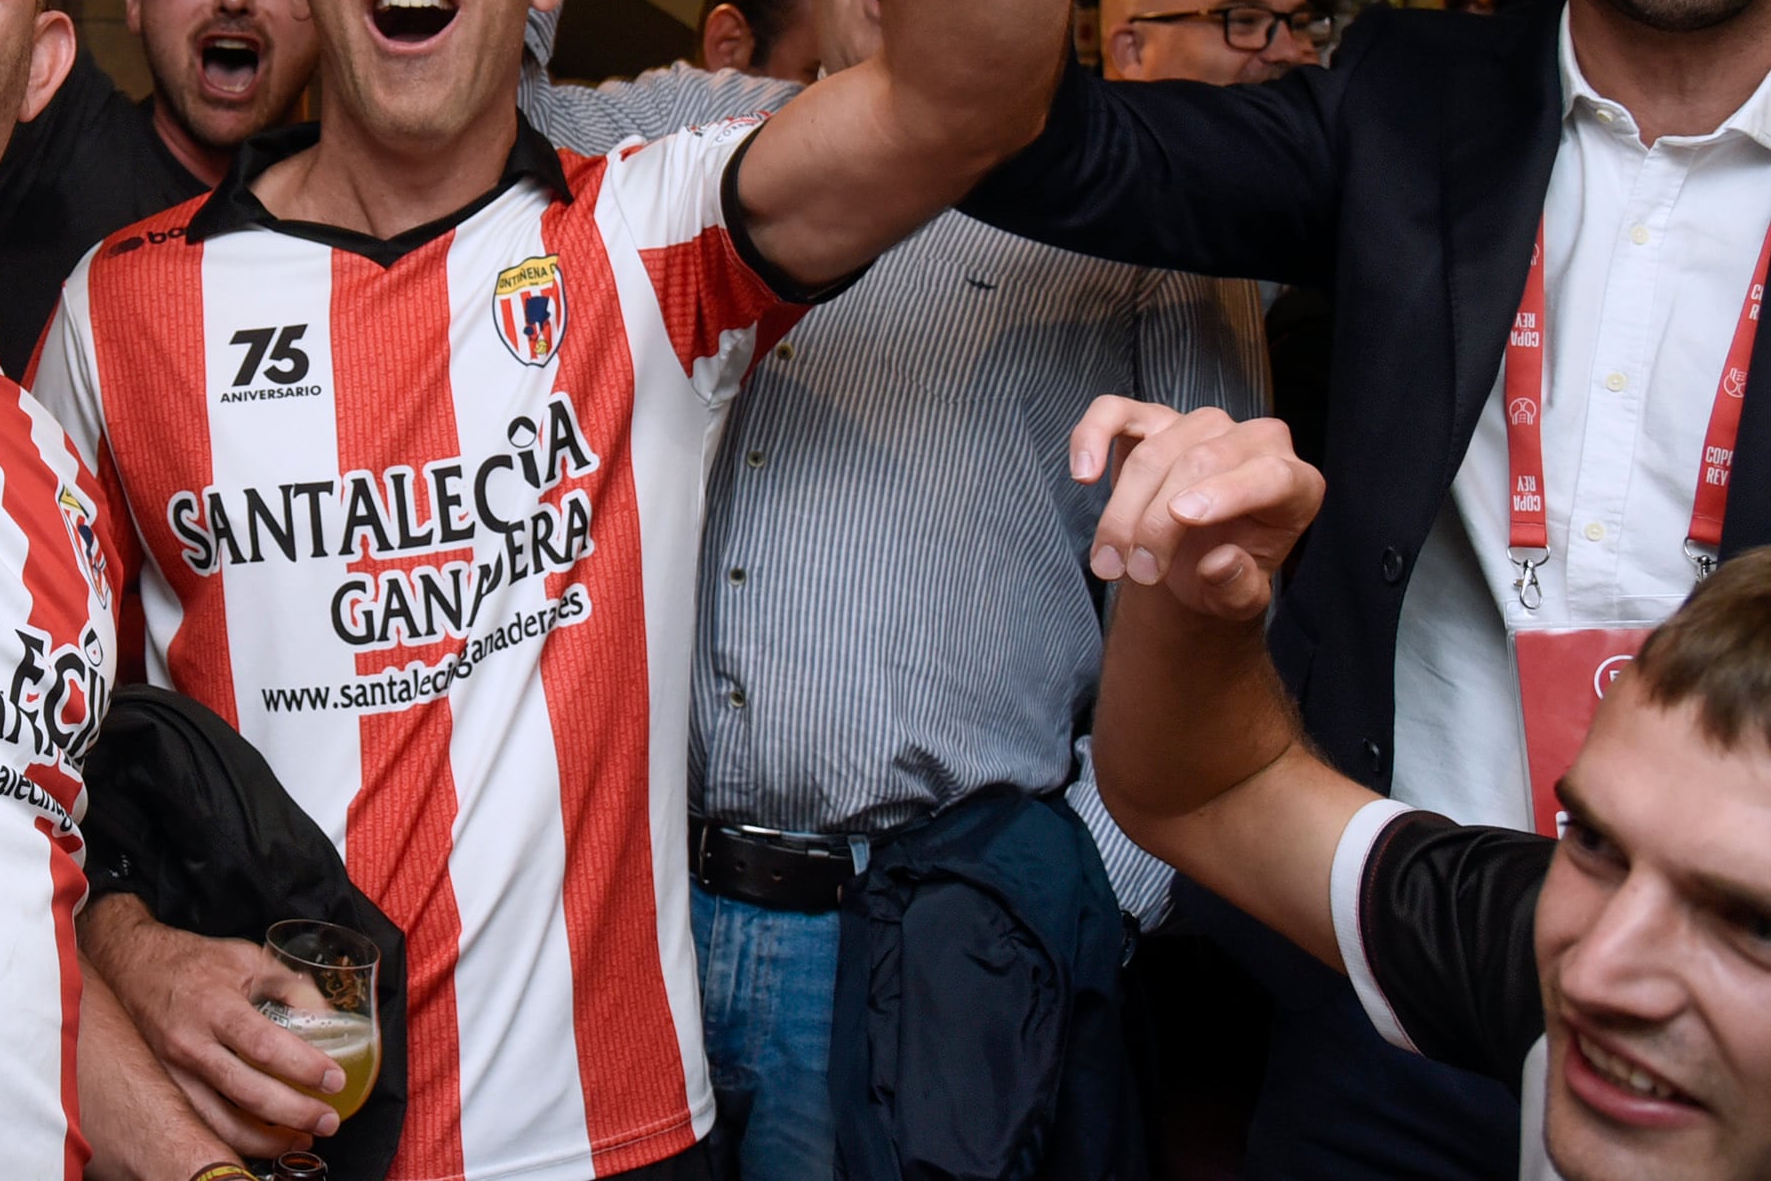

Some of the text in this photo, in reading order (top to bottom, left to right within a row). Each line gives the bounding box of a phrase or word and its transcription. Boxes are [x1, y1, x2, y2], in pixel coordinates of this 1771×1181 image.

[1510, 330, 1540, 348] COPA
[228, 323, 310, 387] 75
[220, 385, 322, 404] ANIVERSARIO
[1517, 475, 1536, 491] REY
[1706, 468, 1729, 486] REY
[1513, 494, 1541, 512] COPA
